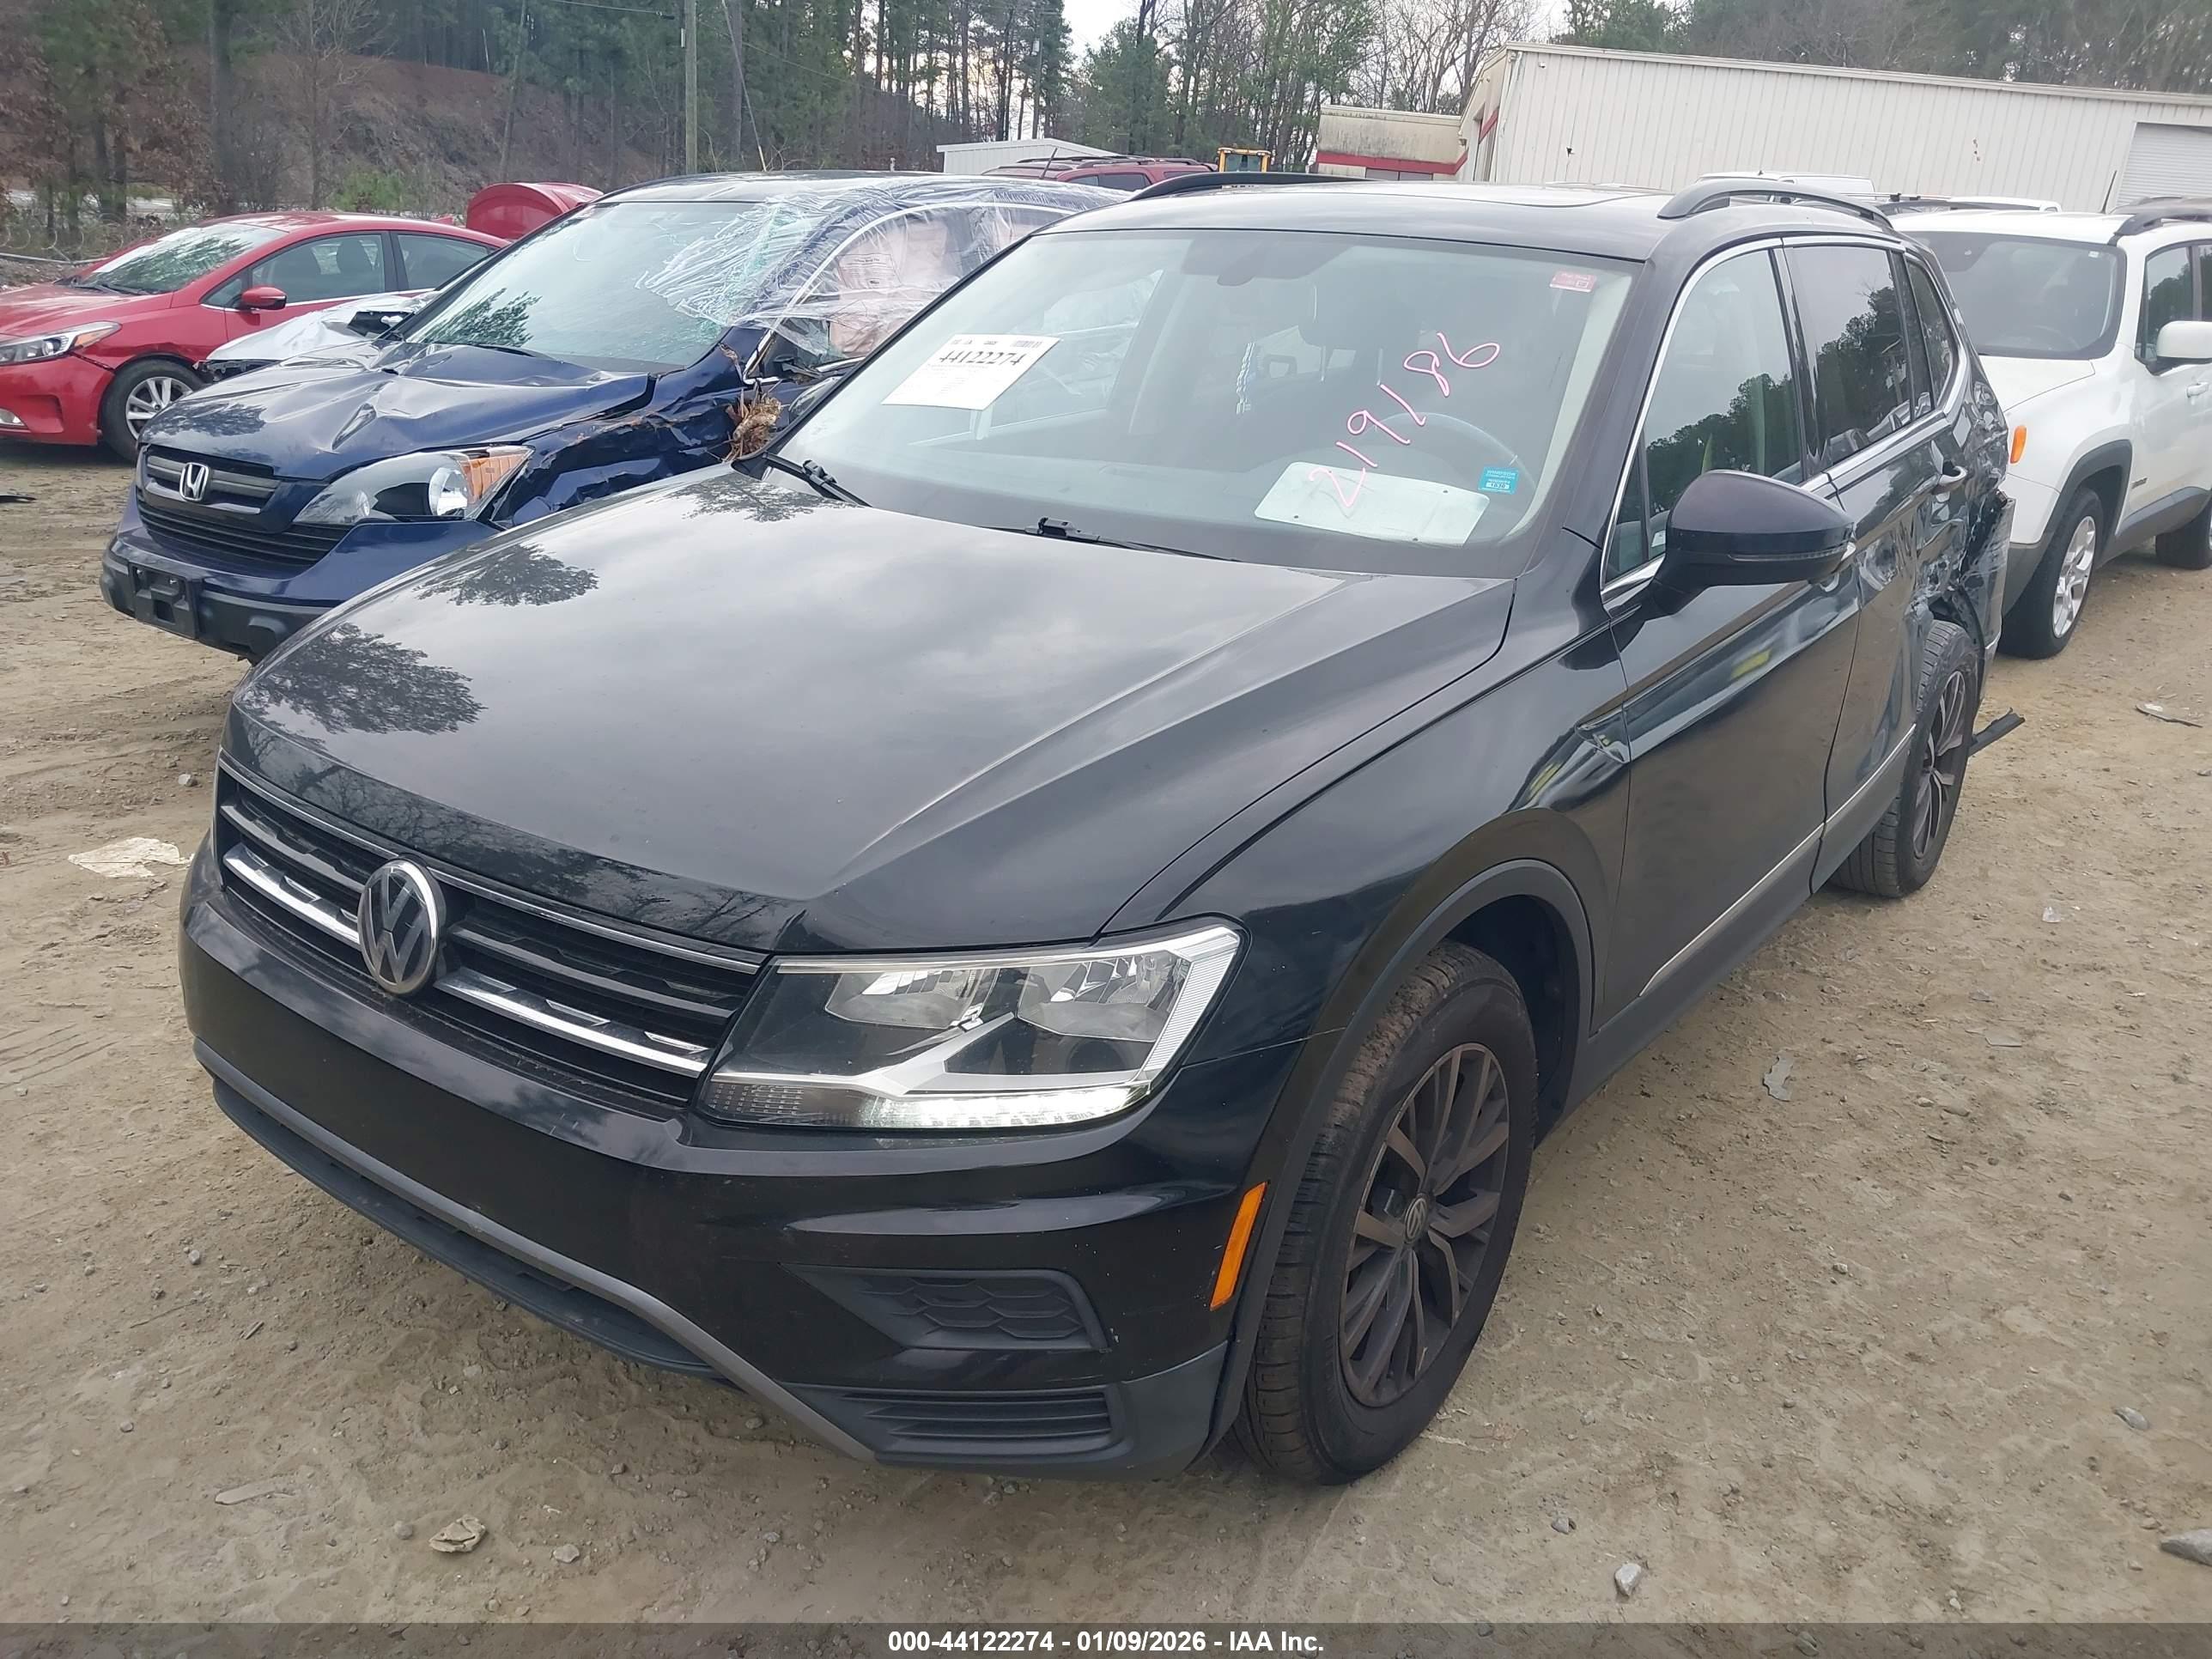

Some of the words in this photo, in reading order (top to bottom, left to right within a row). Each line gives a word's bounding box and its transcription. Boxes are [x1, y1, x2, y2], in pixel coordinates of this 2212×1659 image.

[939, 349, 1028, 366] 44122274
[1308, 331, 1501, 508] 219186
[359, 860, 438, 994] VW
